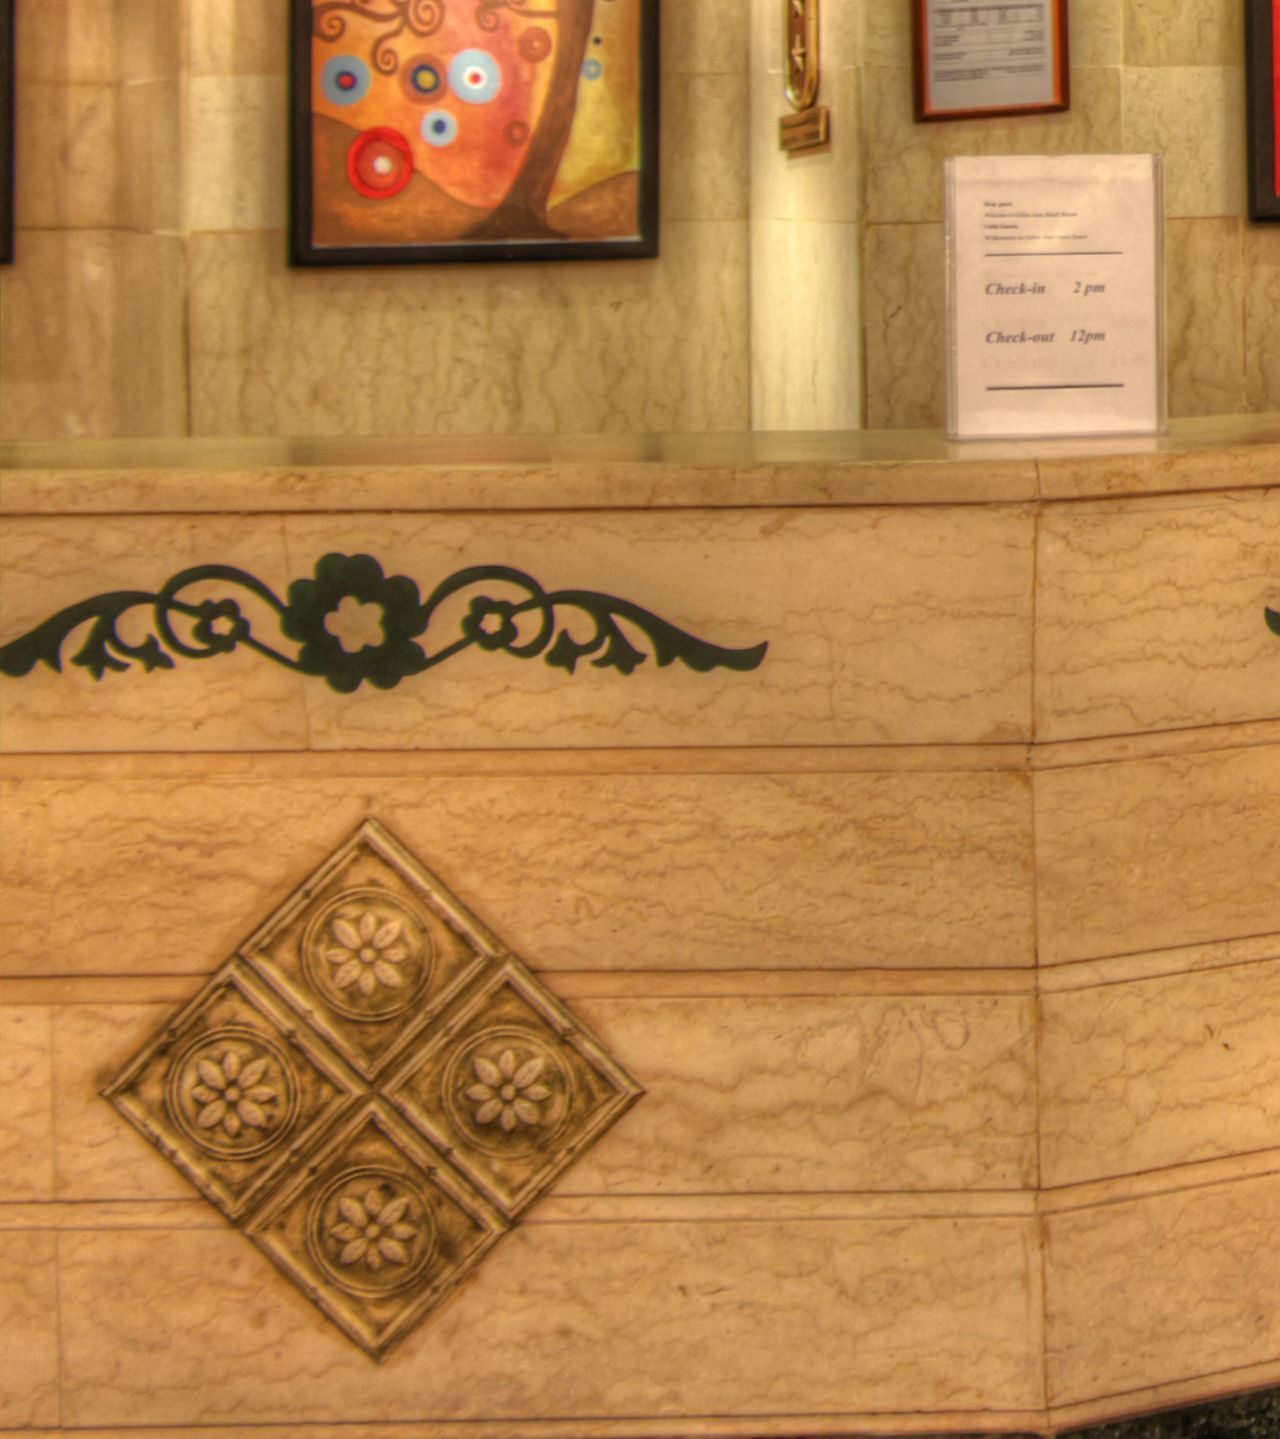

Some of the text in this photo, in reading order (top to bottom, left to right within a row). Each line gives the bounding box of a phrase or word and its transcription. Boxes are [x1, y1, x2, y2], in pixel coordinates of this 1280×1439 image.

[985, 281, 1106, 297] Check-in 2 pm
[985, 329, 1106, 345] Check-out 12pm
